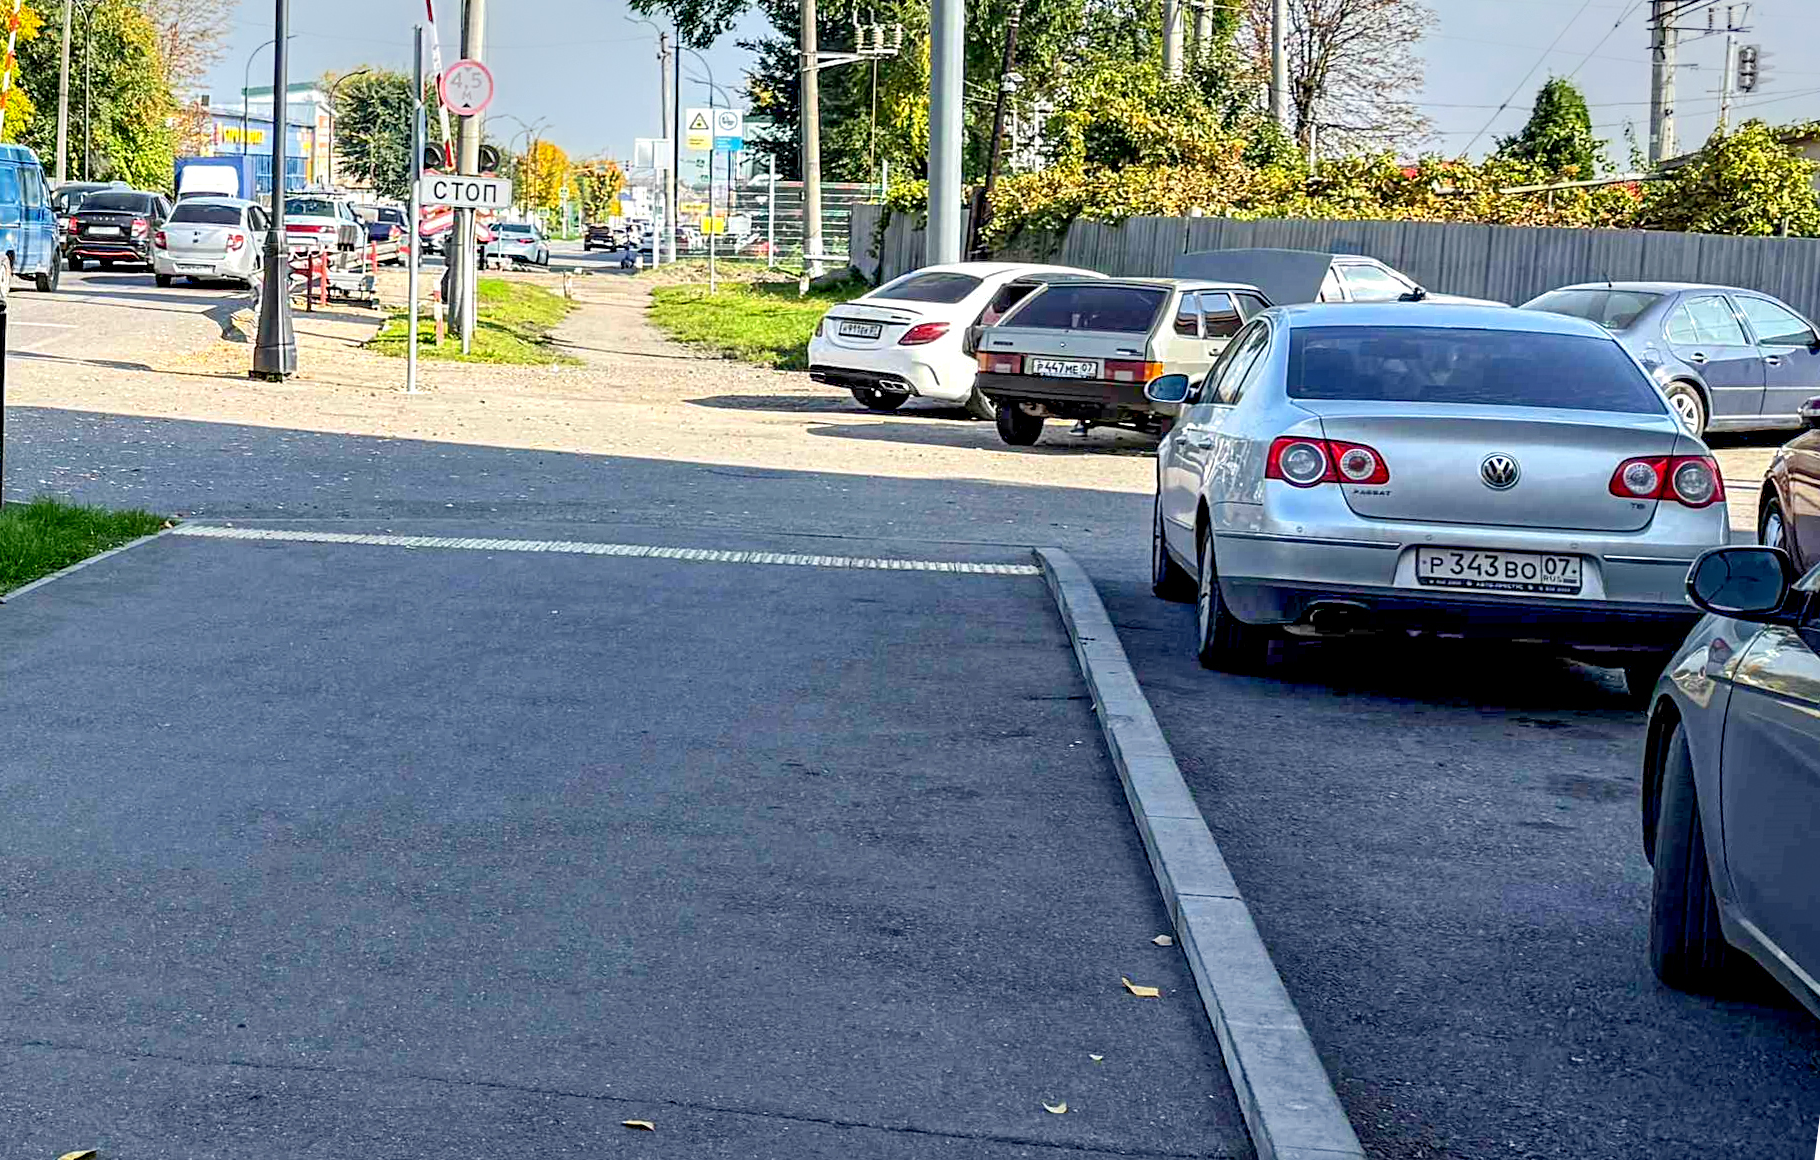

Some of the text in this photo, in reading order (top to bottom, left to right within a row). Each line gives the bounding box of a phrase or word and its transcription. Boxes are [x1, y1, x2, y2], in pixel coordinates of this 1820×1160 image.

[434, 181, 497, 203] СТОП
[1544, 557, 1571, 576] 07
[1543, 575, 1563, 583] RUS
